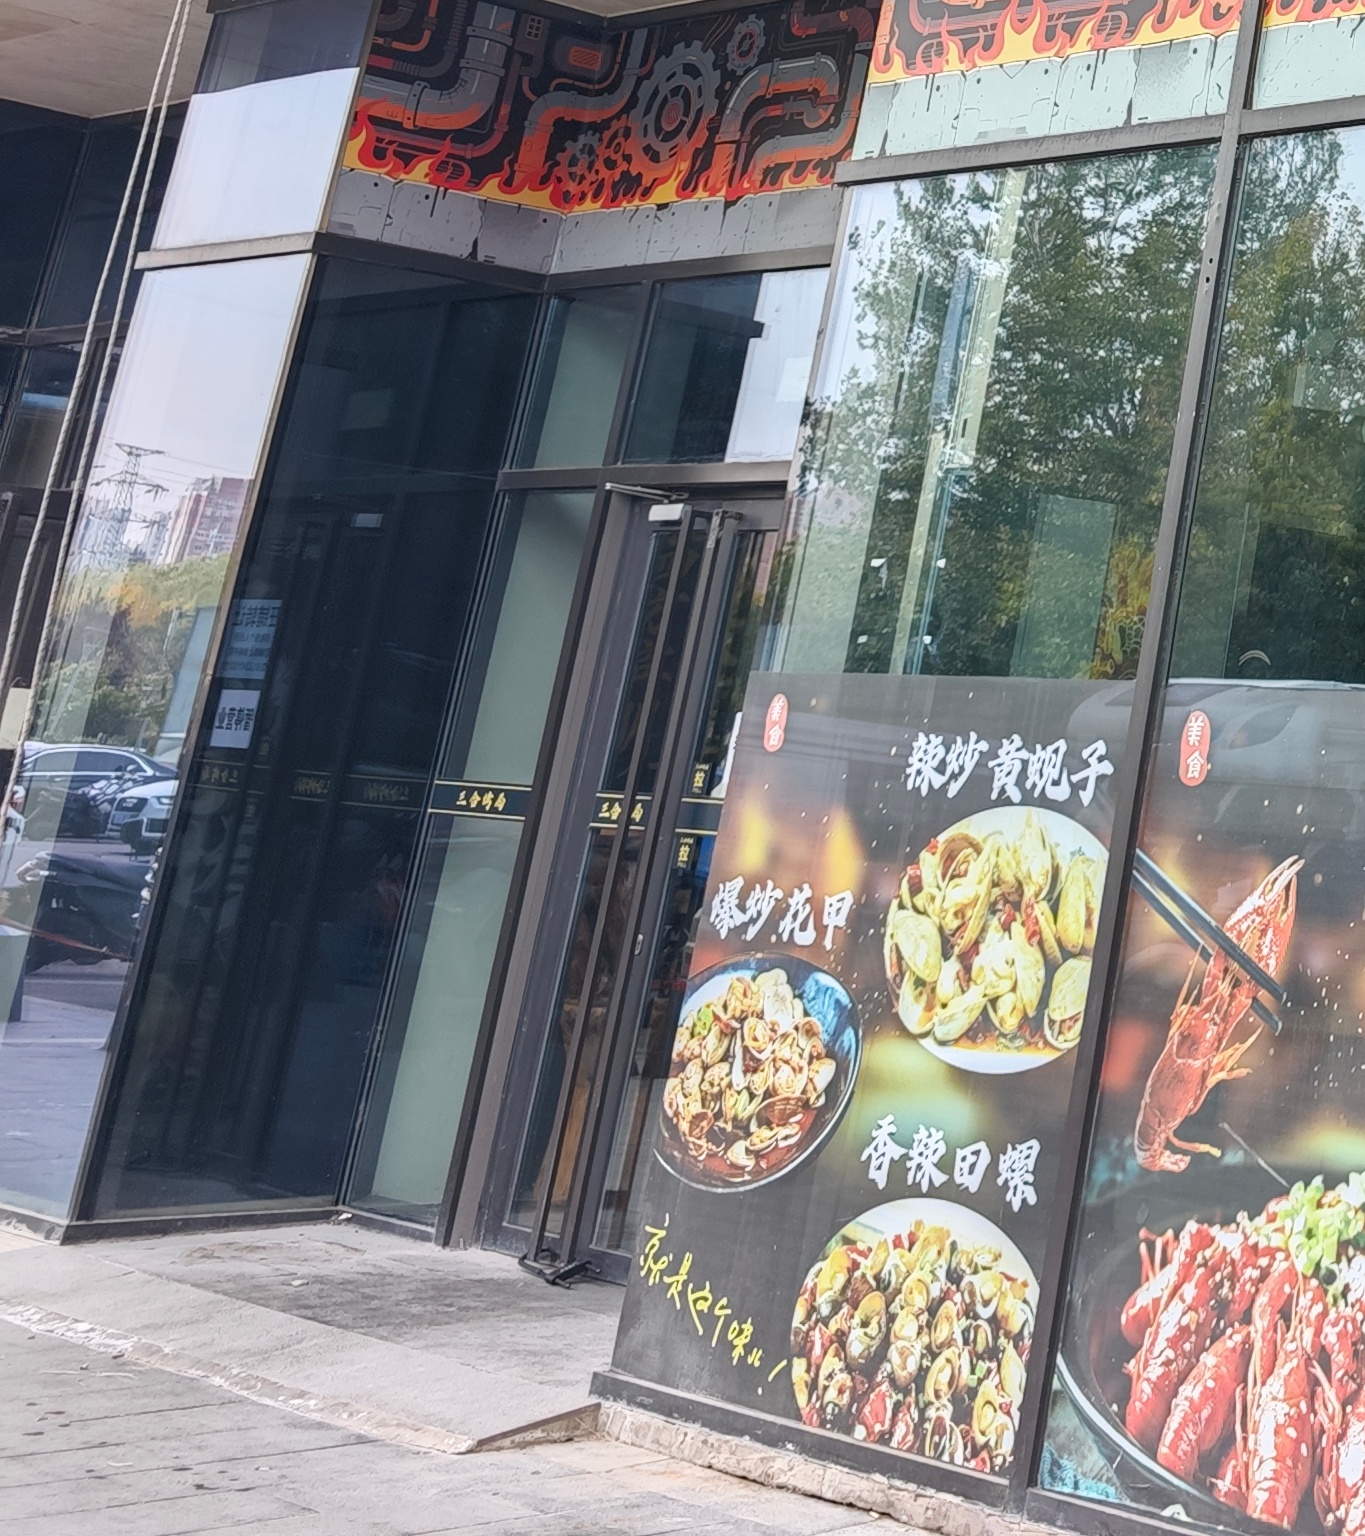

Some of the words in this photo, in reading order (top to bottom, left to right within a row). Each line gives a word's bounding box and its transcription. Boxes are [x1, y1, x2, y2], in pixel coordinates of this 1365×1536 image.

[906, 732, 1115, 807] 辣炒黄蚬子
[710, 875, 854, 951] 爆炒花甲
[860, 1114, 1042, 1213] 香辣田螺
